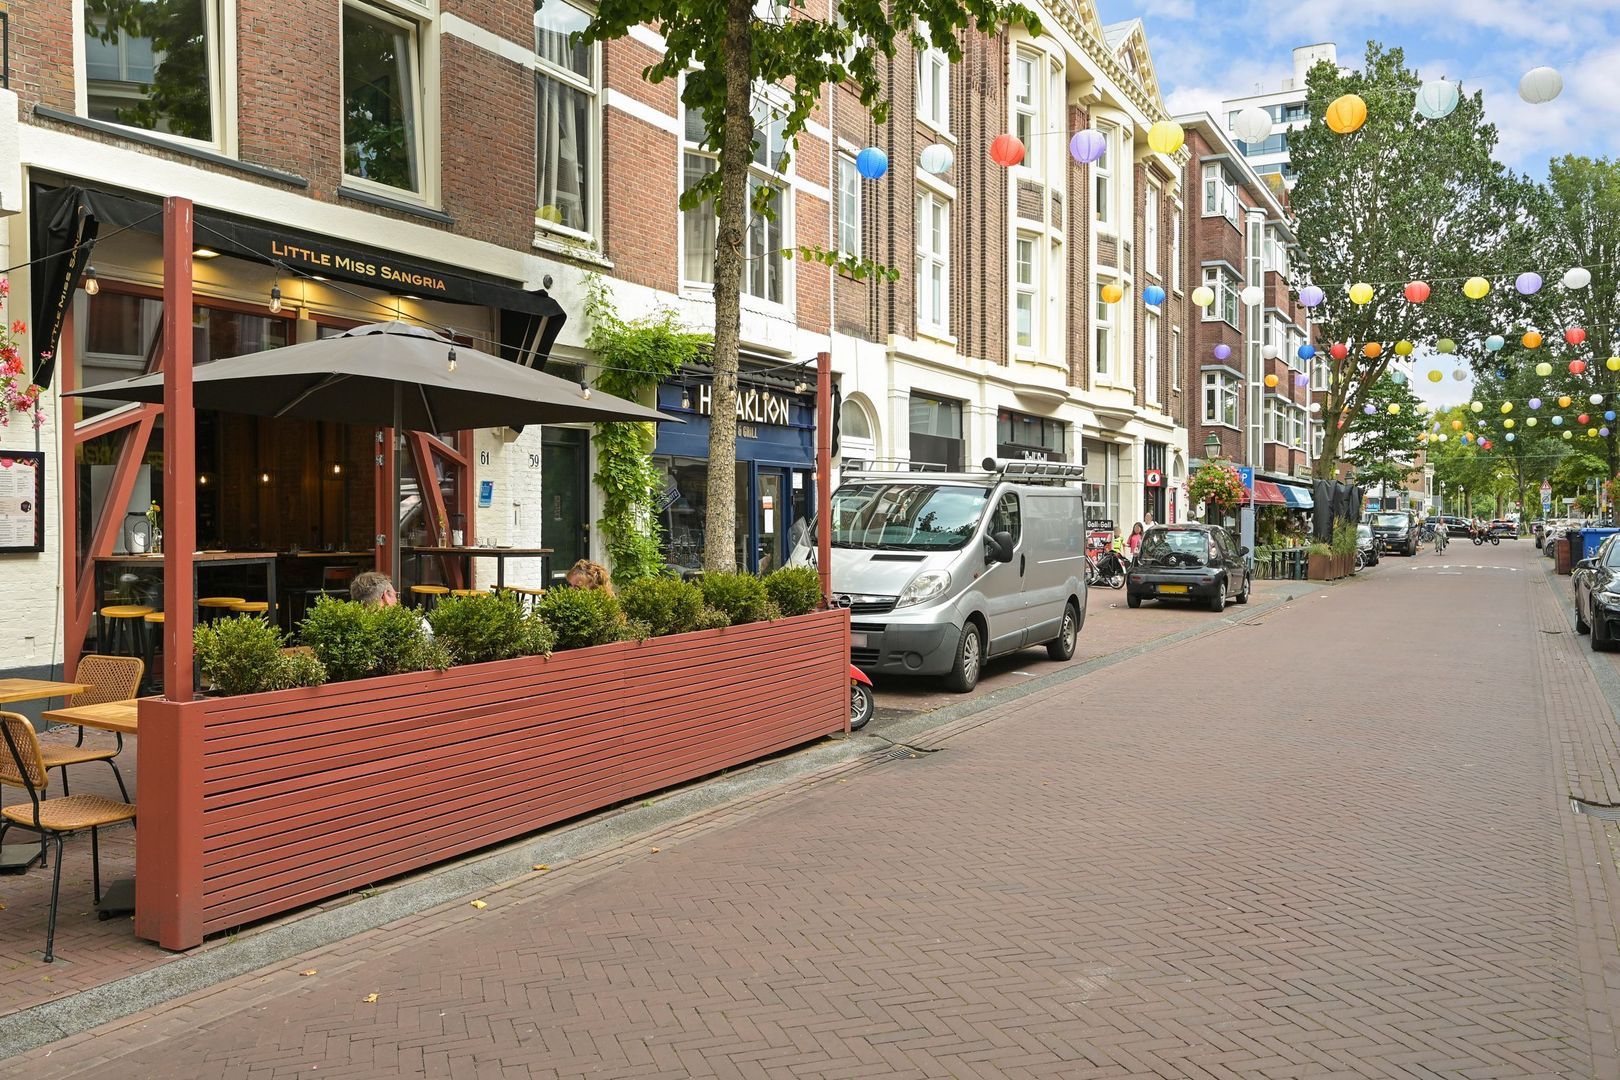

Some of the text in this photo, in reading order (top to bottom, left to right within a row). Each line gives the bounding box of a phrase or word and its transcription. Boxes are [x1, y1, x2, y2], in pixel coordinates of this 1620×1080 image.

[271, 241, 446, 291] LITTLE MISS SANGRIA
[58, 272, 71, 307] MISS
[700, 384, 790, 426] HAKLION
[743, 427, 759, 439] GRILL
[480, 451, 490, 465] 61
[529, 454, 539, 468] 59
[1241, 473, 1248, 482] P
